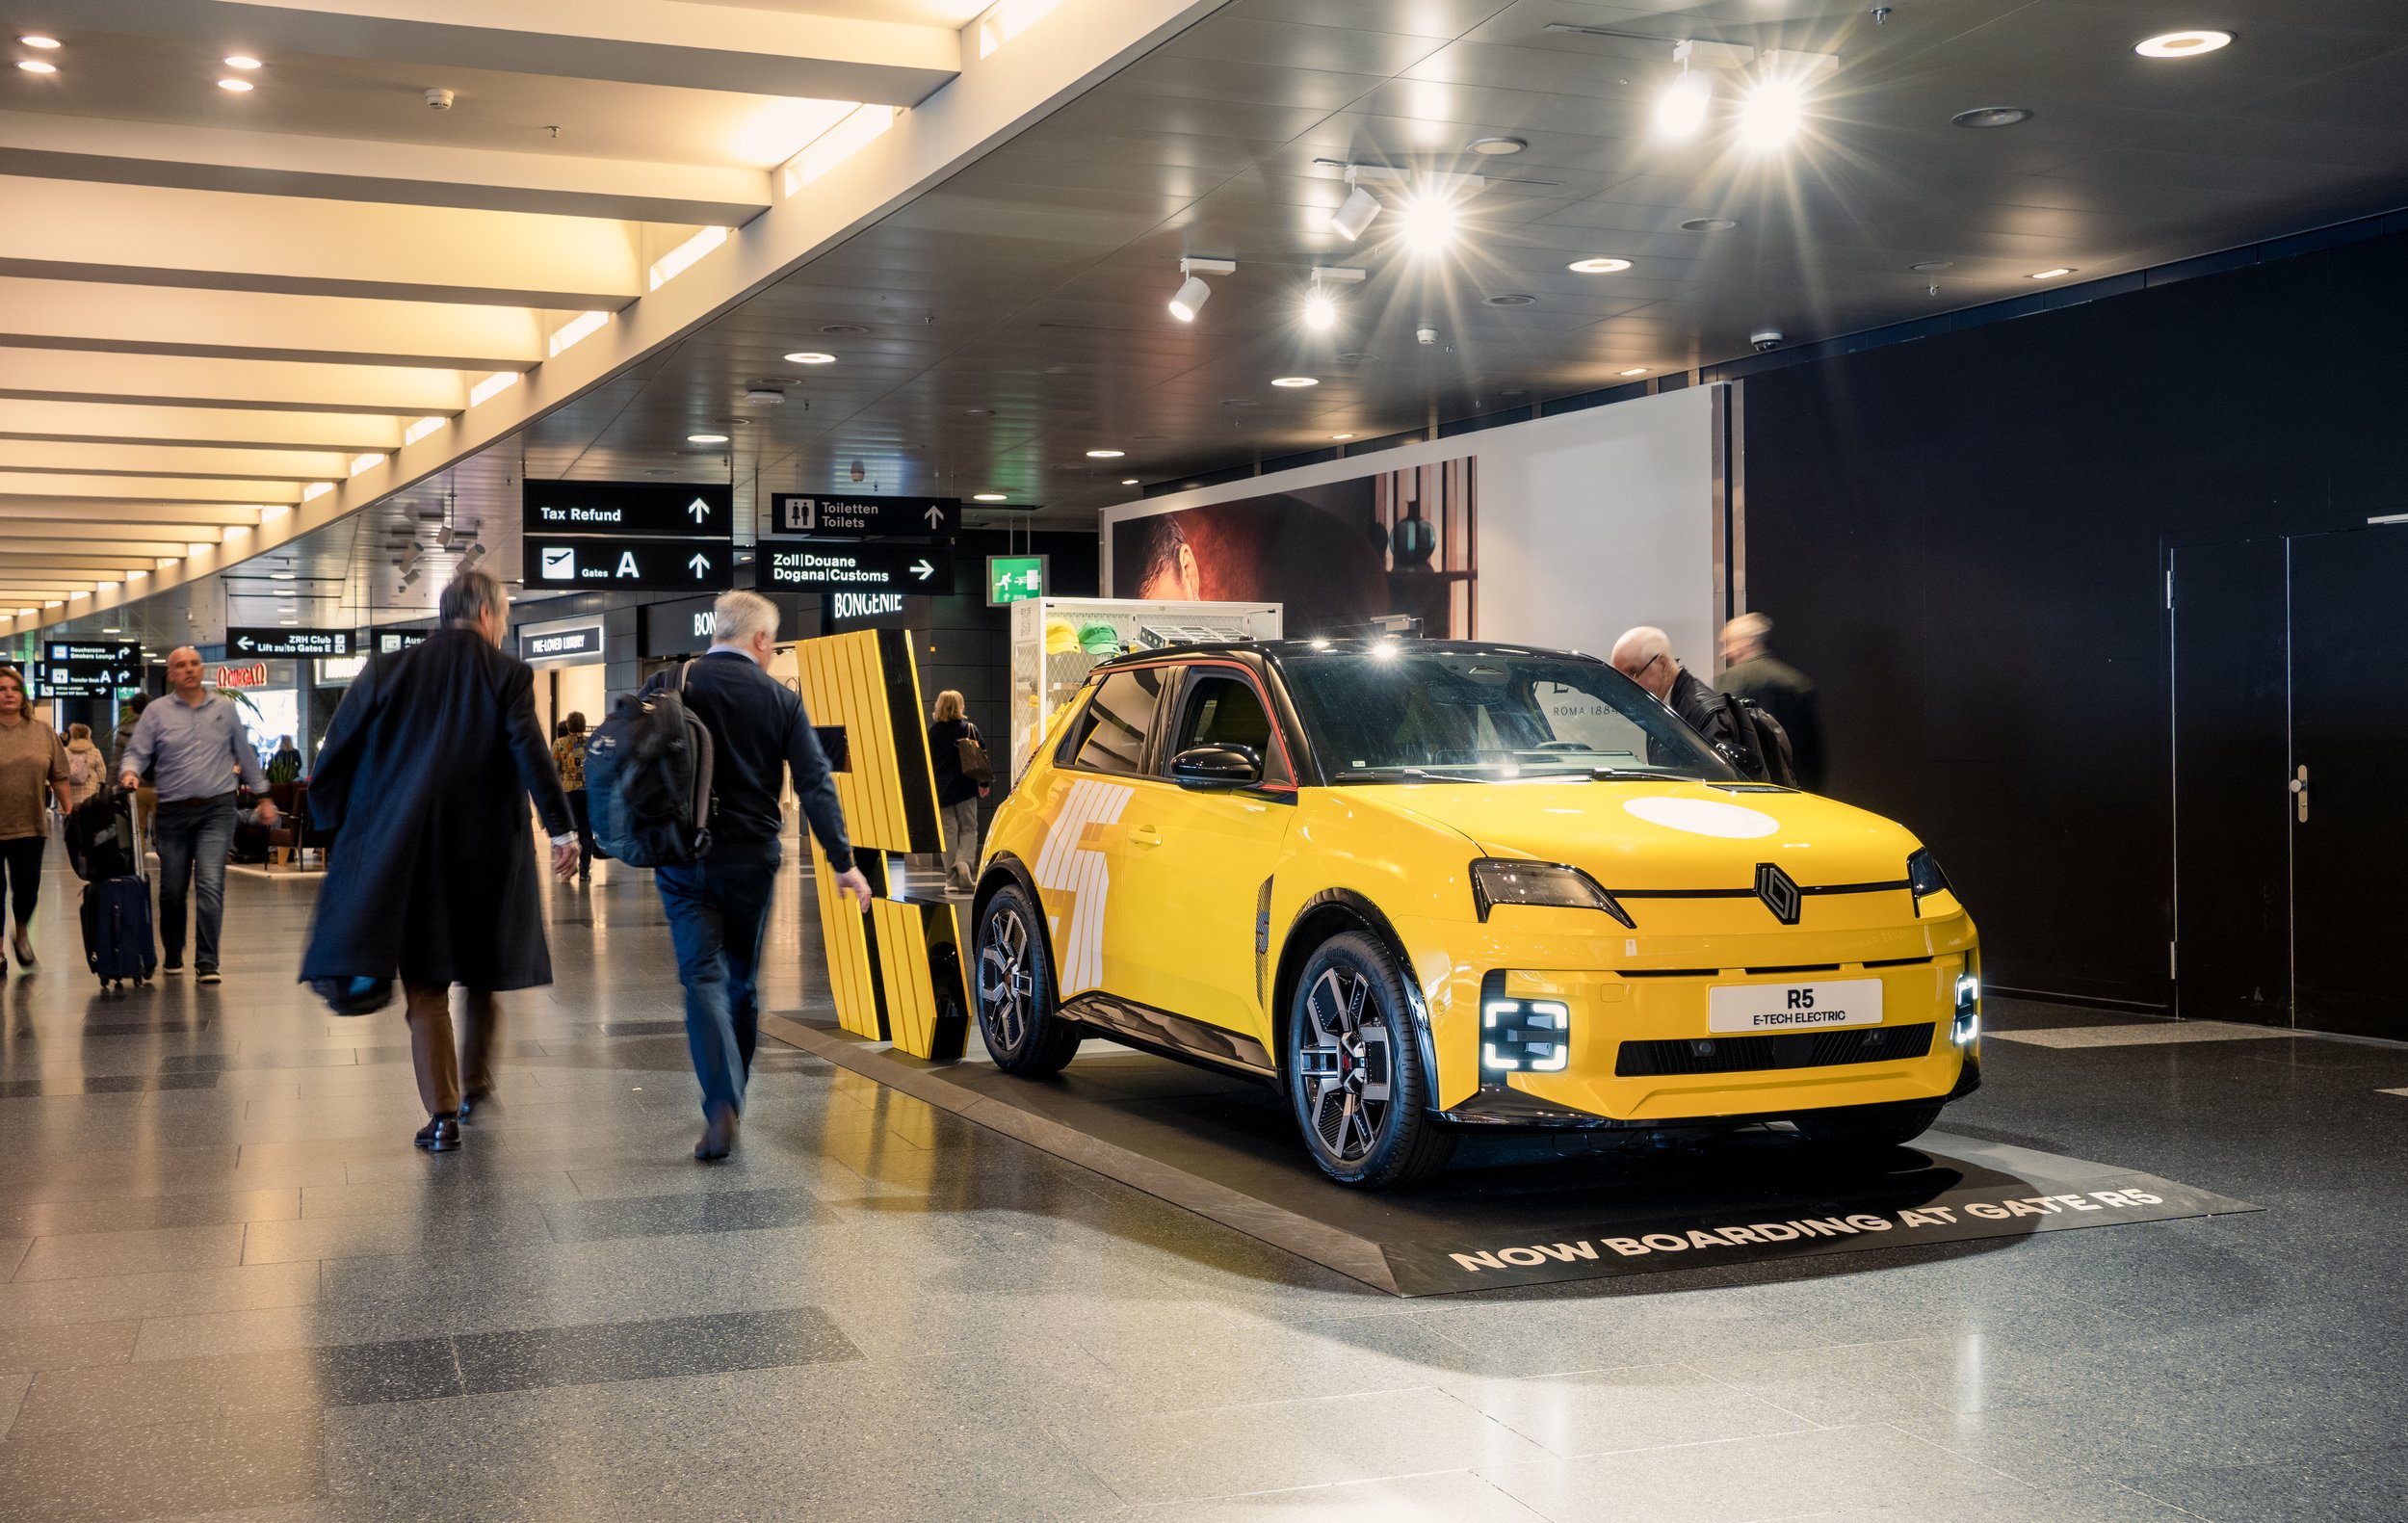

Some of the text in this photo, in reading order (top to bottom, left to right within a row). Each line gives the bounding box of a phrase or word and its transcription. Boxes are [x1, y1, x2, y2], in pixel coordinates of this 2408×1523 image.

[540, 508, 621, 521] Tax Refund
[822, 502, 878, 514] Toiletten
[822, 516, 865, 528] Toilets
[582, 551, 640, 578] Gates A
[288, 635, 331, 644] ZRH Club
[257, 643, 272, 652] Lift
[298, 643, 323, 653] Gates
[100, 670, 112, 683] A
[1553, 706, 1585, 716] ROMA
[1787, 988, 1815, 1010] R5
[1753, 1011, 1845, 1026] E-TECH ELECTRIC
[1448, 1188, 2163, 1272] NOW BOARDING AT GATE R5
